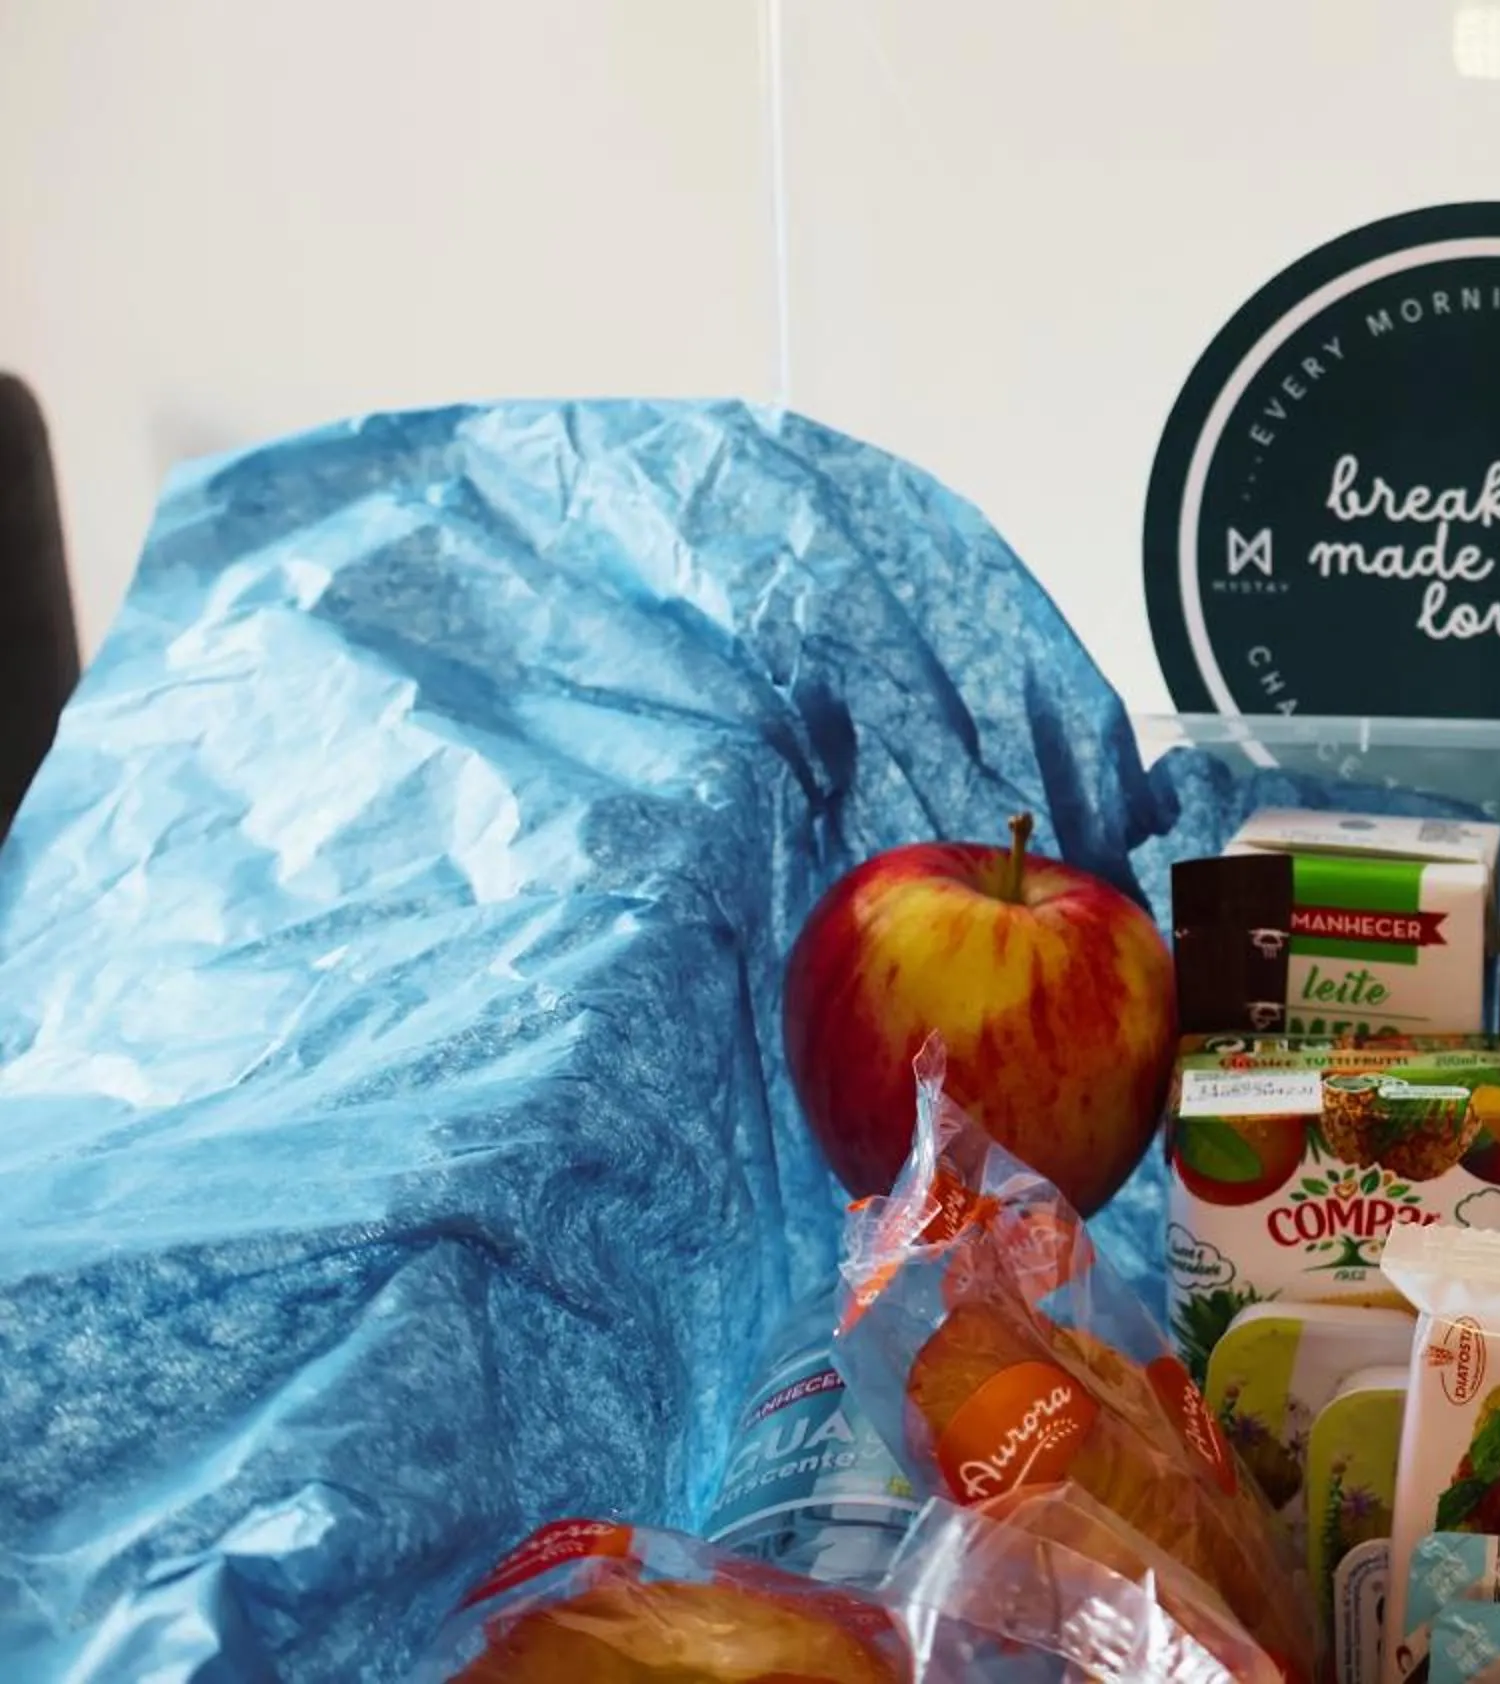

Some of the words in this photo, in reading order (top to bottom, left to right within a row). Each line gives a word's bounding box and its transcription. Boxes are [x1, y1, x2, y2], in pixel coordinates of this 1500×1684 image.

[1249, 336, 1344, 446] EVERY
[1308, 518, 1495, 581] made
[1248, 645, 1362, 780] CHACE
[1290, 911, 1422, 940] MANHECER
[1302, 964, 1391, 1006] leite
[1267, 1197, 1441, 1247] COMP
[724, 1410, 855, 1488] GUA
[959, 1386, 1072, 1498] Aurora
